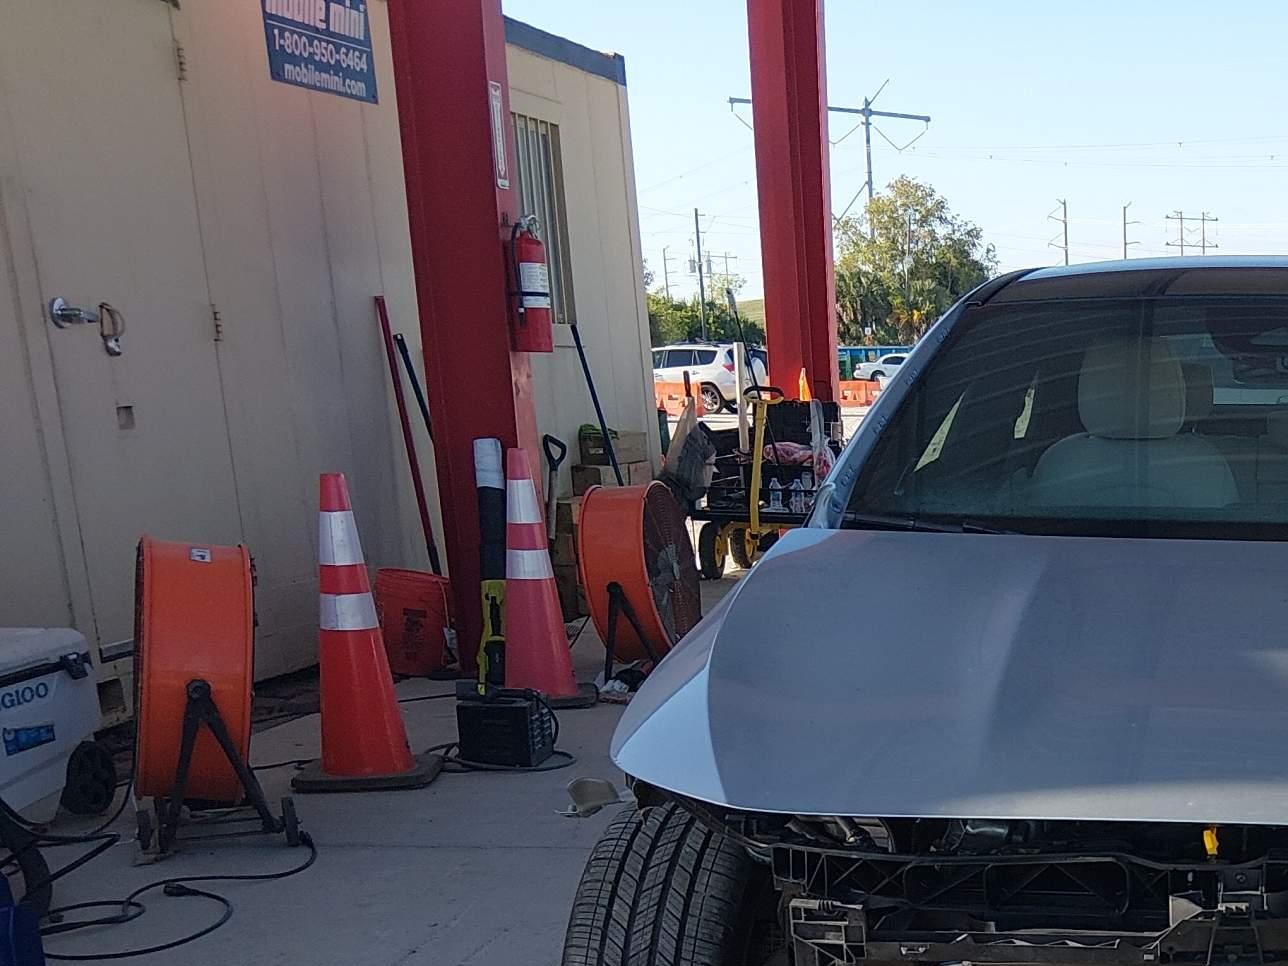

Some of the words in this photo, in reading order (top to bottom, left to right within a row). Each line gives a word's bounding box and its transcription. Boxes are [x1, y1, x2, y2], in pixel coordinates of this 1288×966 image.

[329, 0, 365, 40] mini
[273, 28, 368, 72] 1-800-950-6464
[283, 63, 367, 97] mobilemini.com
[0, 682, 49, 711] GLOO
